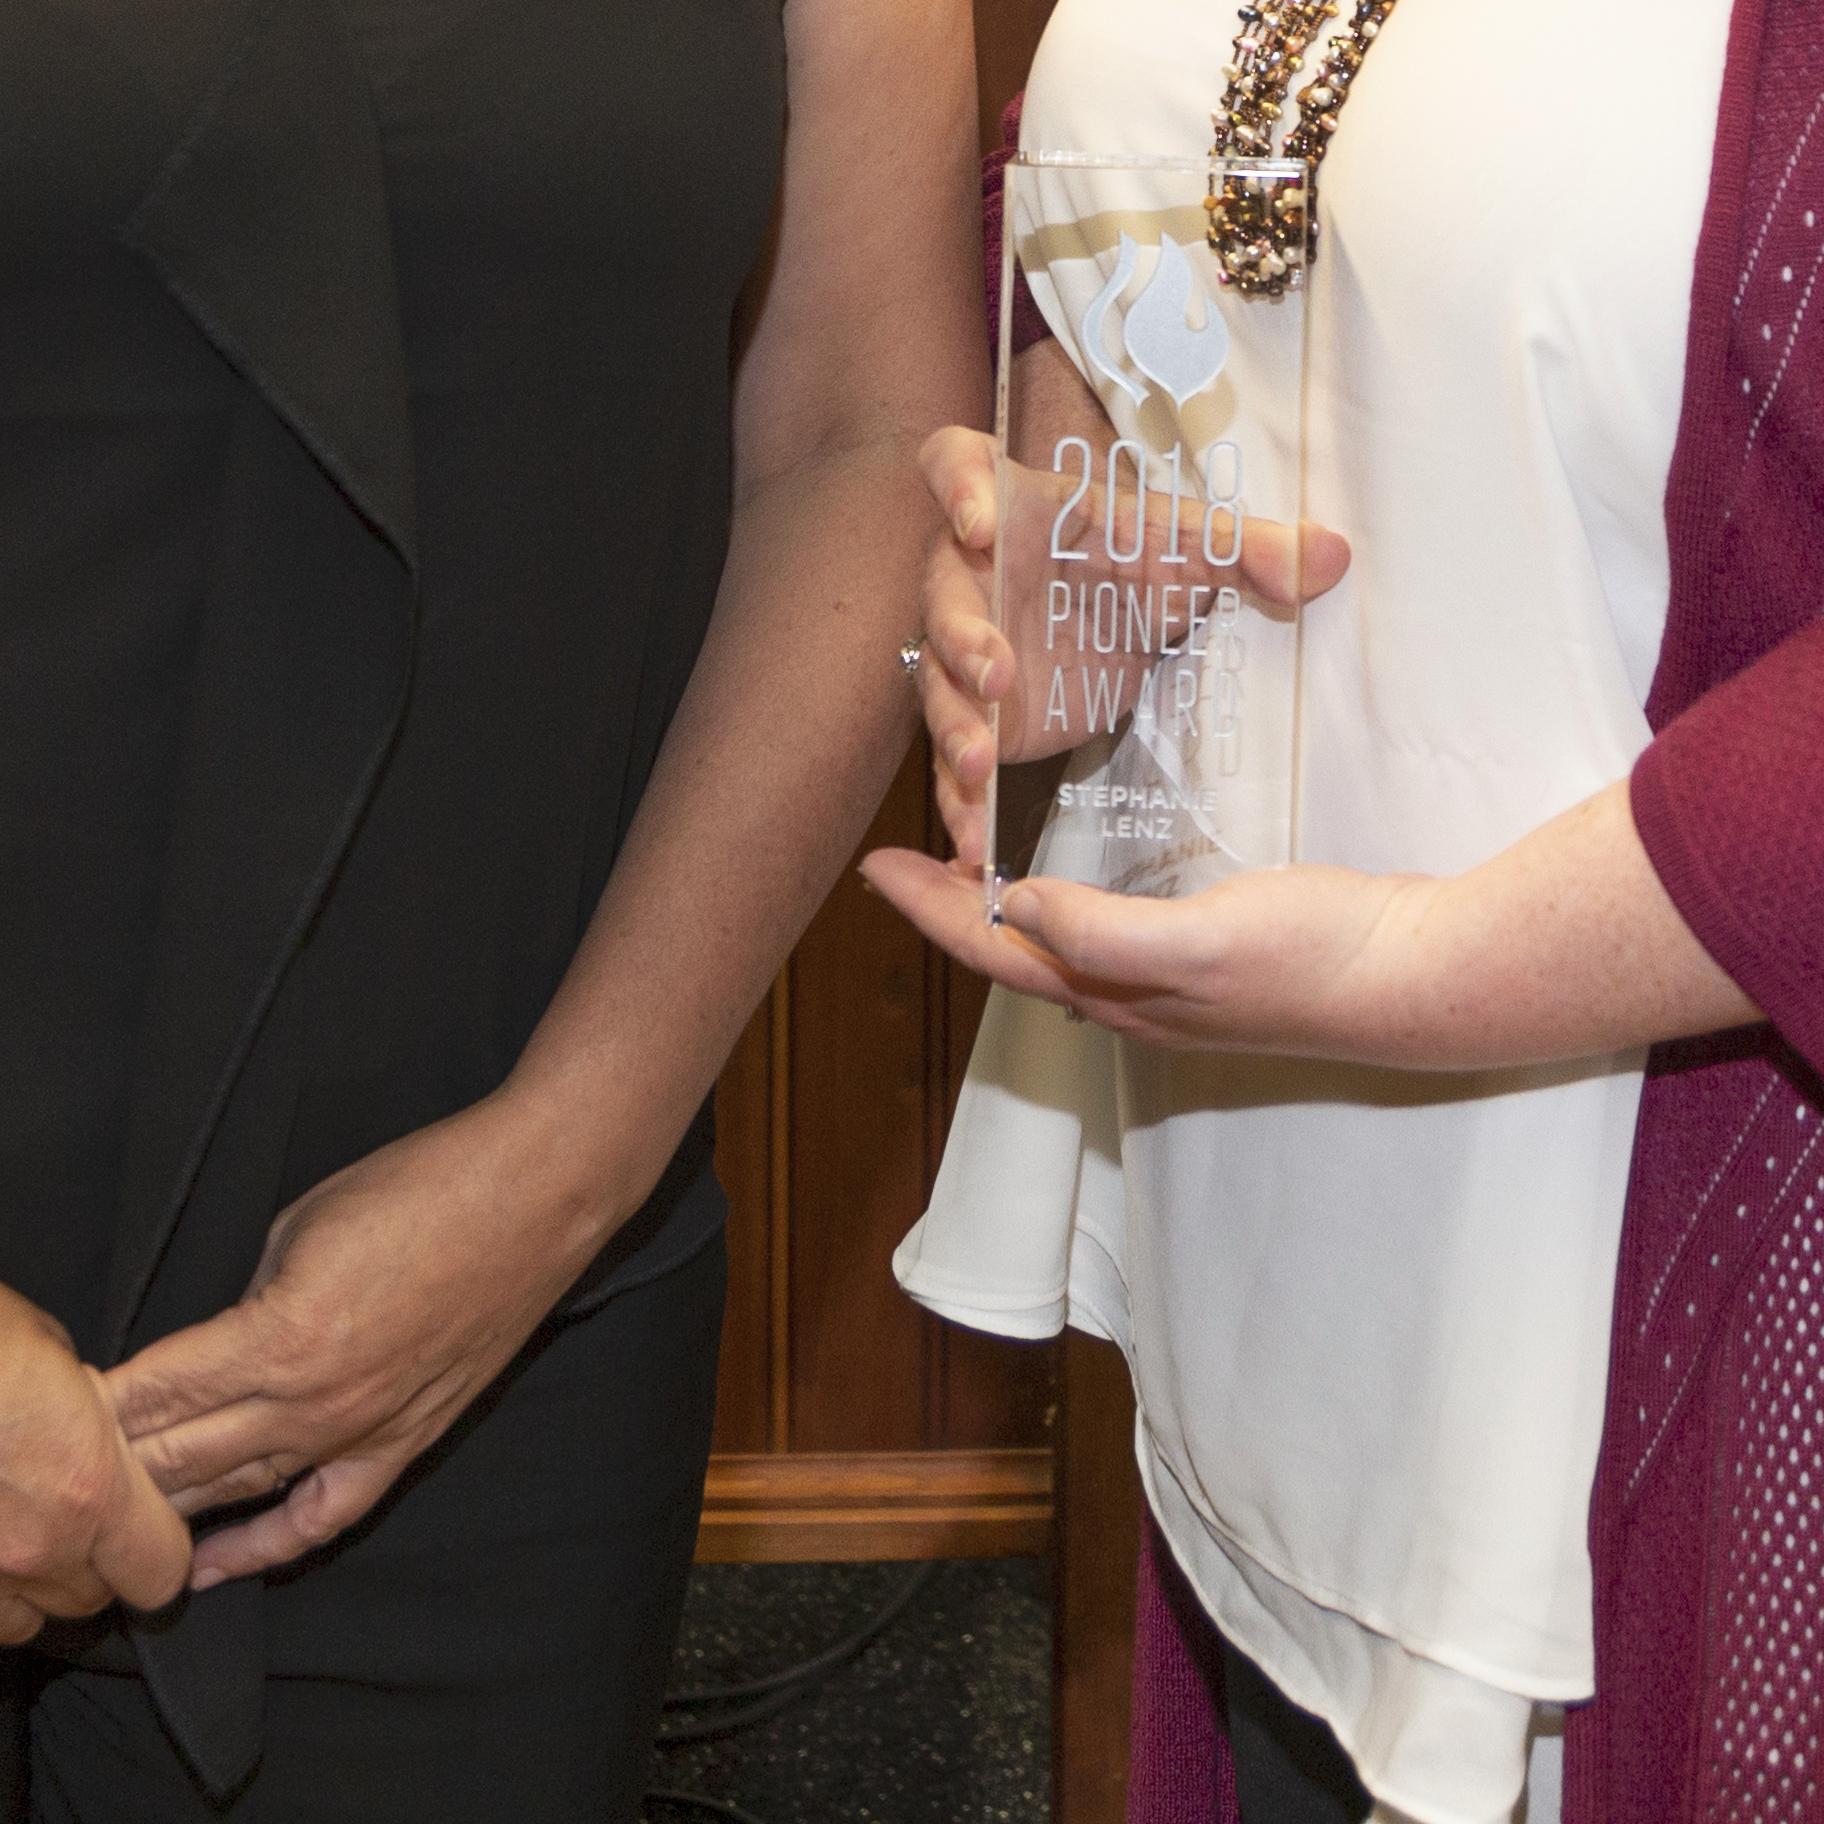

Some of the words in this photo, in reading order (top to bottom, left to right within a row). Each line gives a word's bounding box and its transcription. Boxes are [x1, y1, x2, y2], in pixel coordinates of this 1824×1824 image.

[1050, 435, 1243, 567] 2018
[1046, 580, 1242, 656] PIONEER
[1044, 665, 1238, 738] AWARD
[1101, 815, 1174, 840] LENZ
